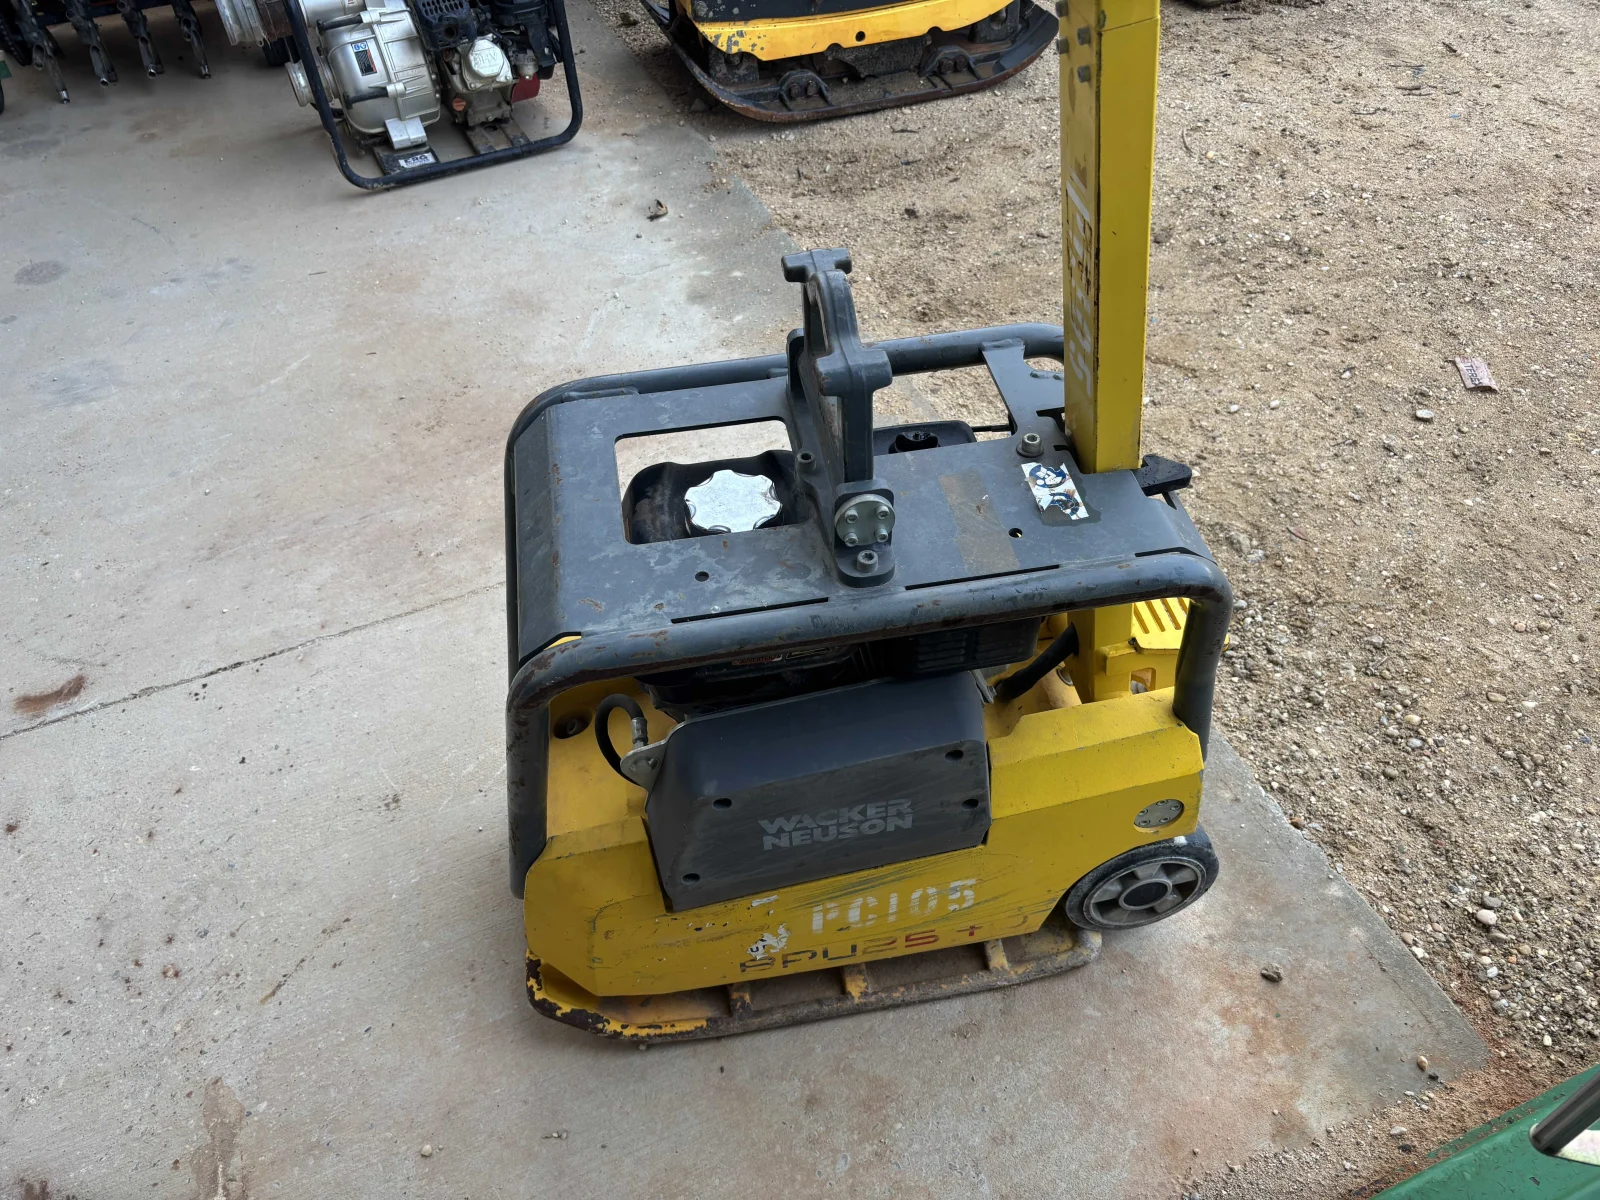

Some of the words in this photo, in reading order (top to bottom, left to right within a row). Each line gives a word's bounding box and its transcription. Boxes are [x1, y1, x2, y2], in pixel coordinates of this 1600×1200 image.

[1464, 364, 1482, 387] TEREX
[758, 799, 915, 834] WACKER
[763, 814, 913, 850] NEUSON
[812, 878, 977, 933] PC105
